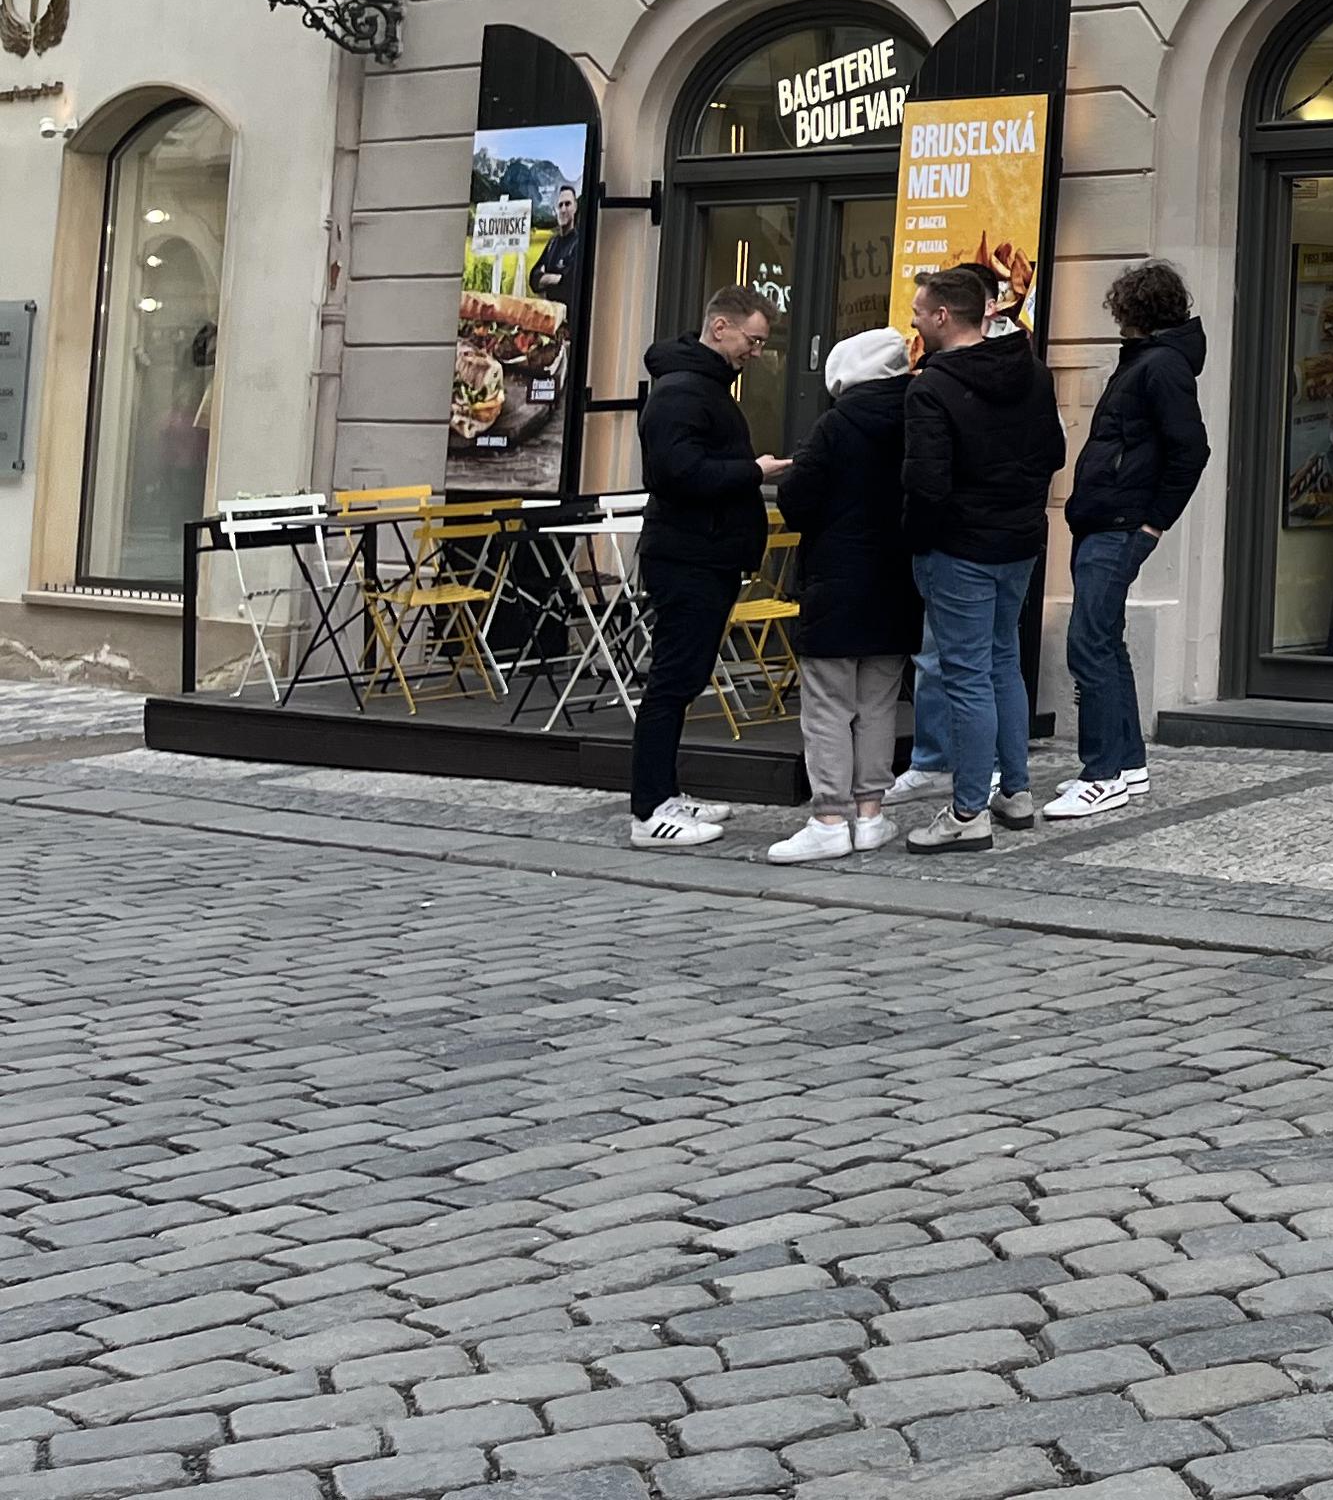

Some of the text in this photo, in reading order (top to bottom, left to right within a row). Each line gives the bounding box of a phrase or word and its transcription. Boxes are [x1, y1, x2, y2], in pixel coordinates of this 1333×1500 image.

[778, 38, 896, 117] BAGETERIE
[796, 85, 909, 148] BOULEVAR
[910, 110, 1036, 159] BRUSELSKÁ
[907, 163, 971, 200] MENU
[478, 212, 527, 236] SLOVINSKÉ
